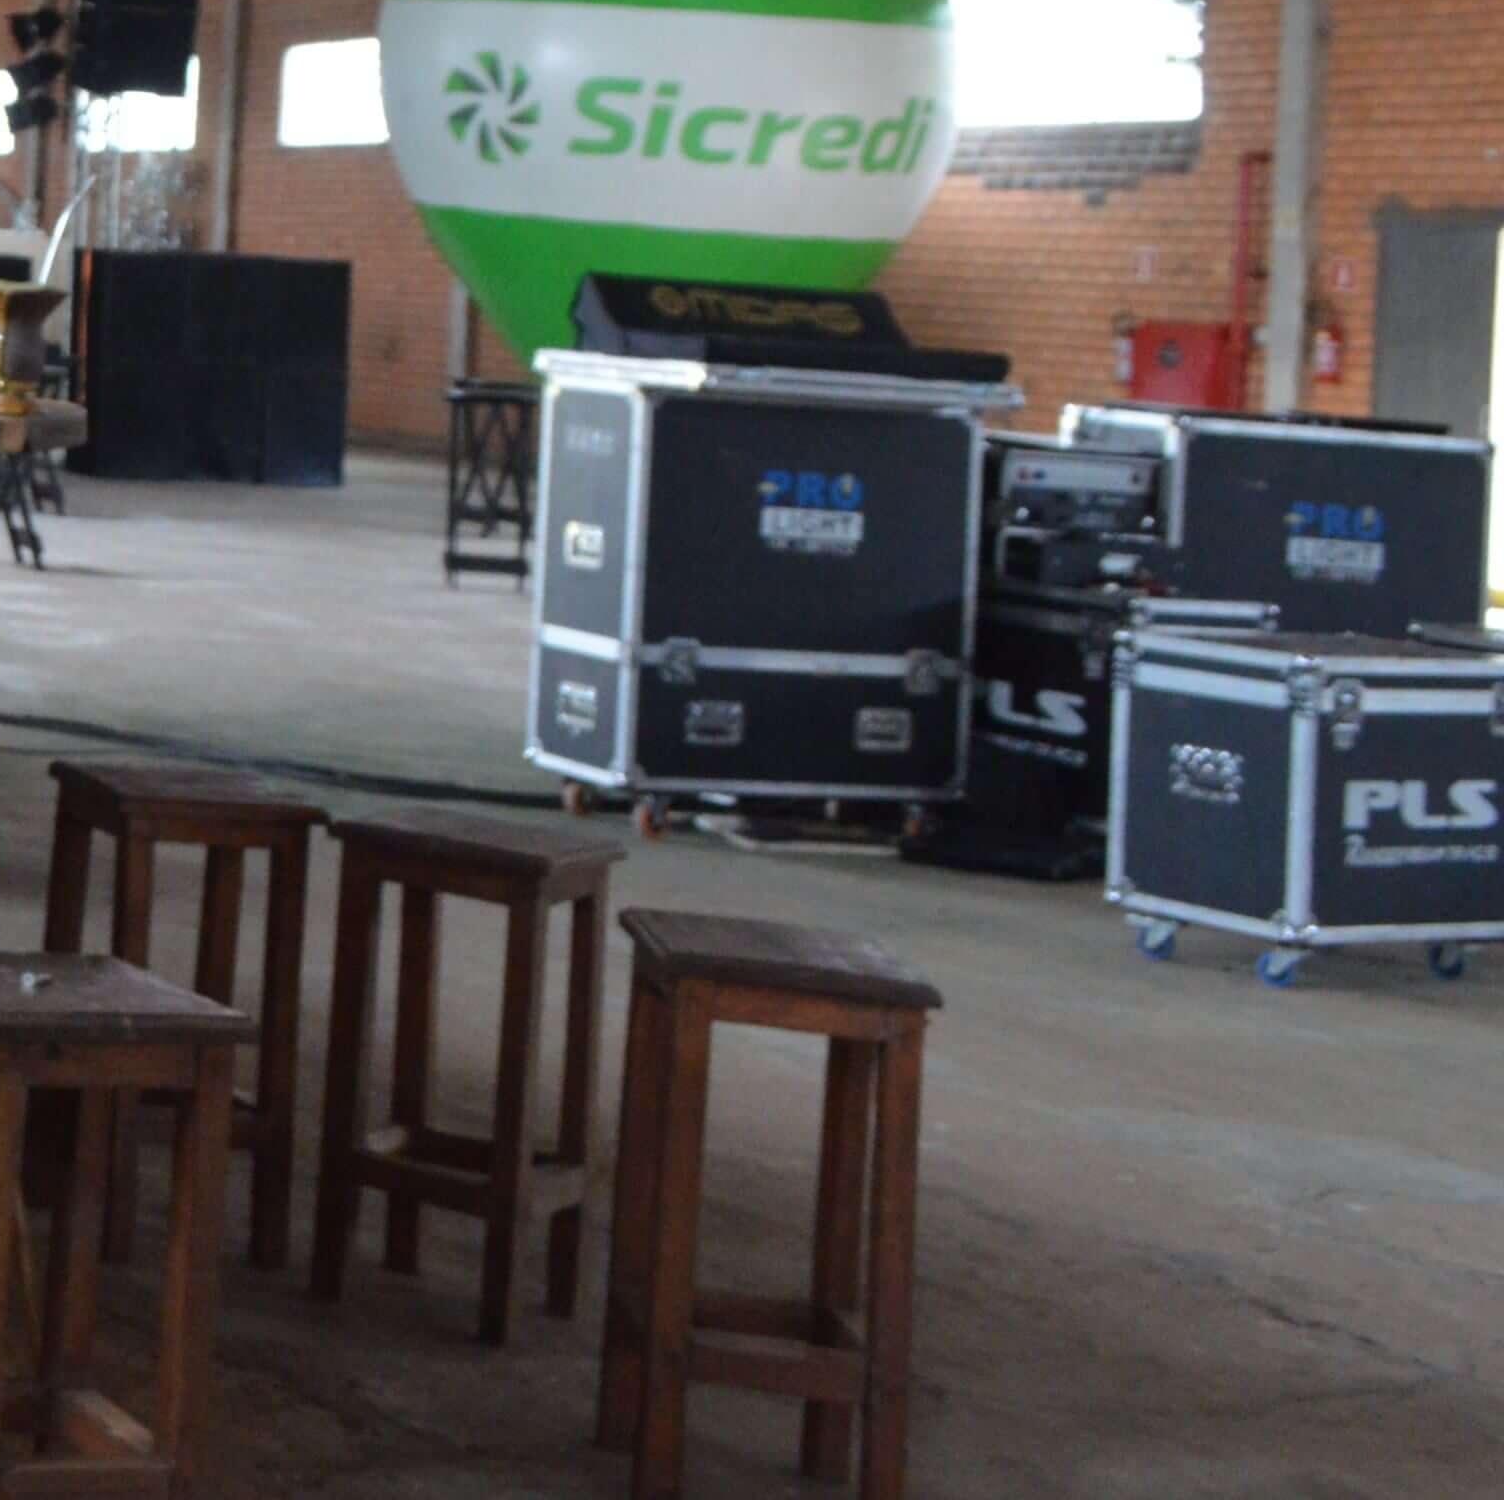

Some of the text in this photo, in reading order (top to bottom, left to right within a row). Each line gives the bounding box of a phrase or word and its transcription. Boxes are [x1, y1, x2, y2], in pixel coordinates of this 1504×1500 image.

[568, 76, 933, 174] Sicredi
[759, 470, 862, 508] PRO
[1284, 503, 1383, 539] PRO
[1343, 779, 1499, 829] PLS
